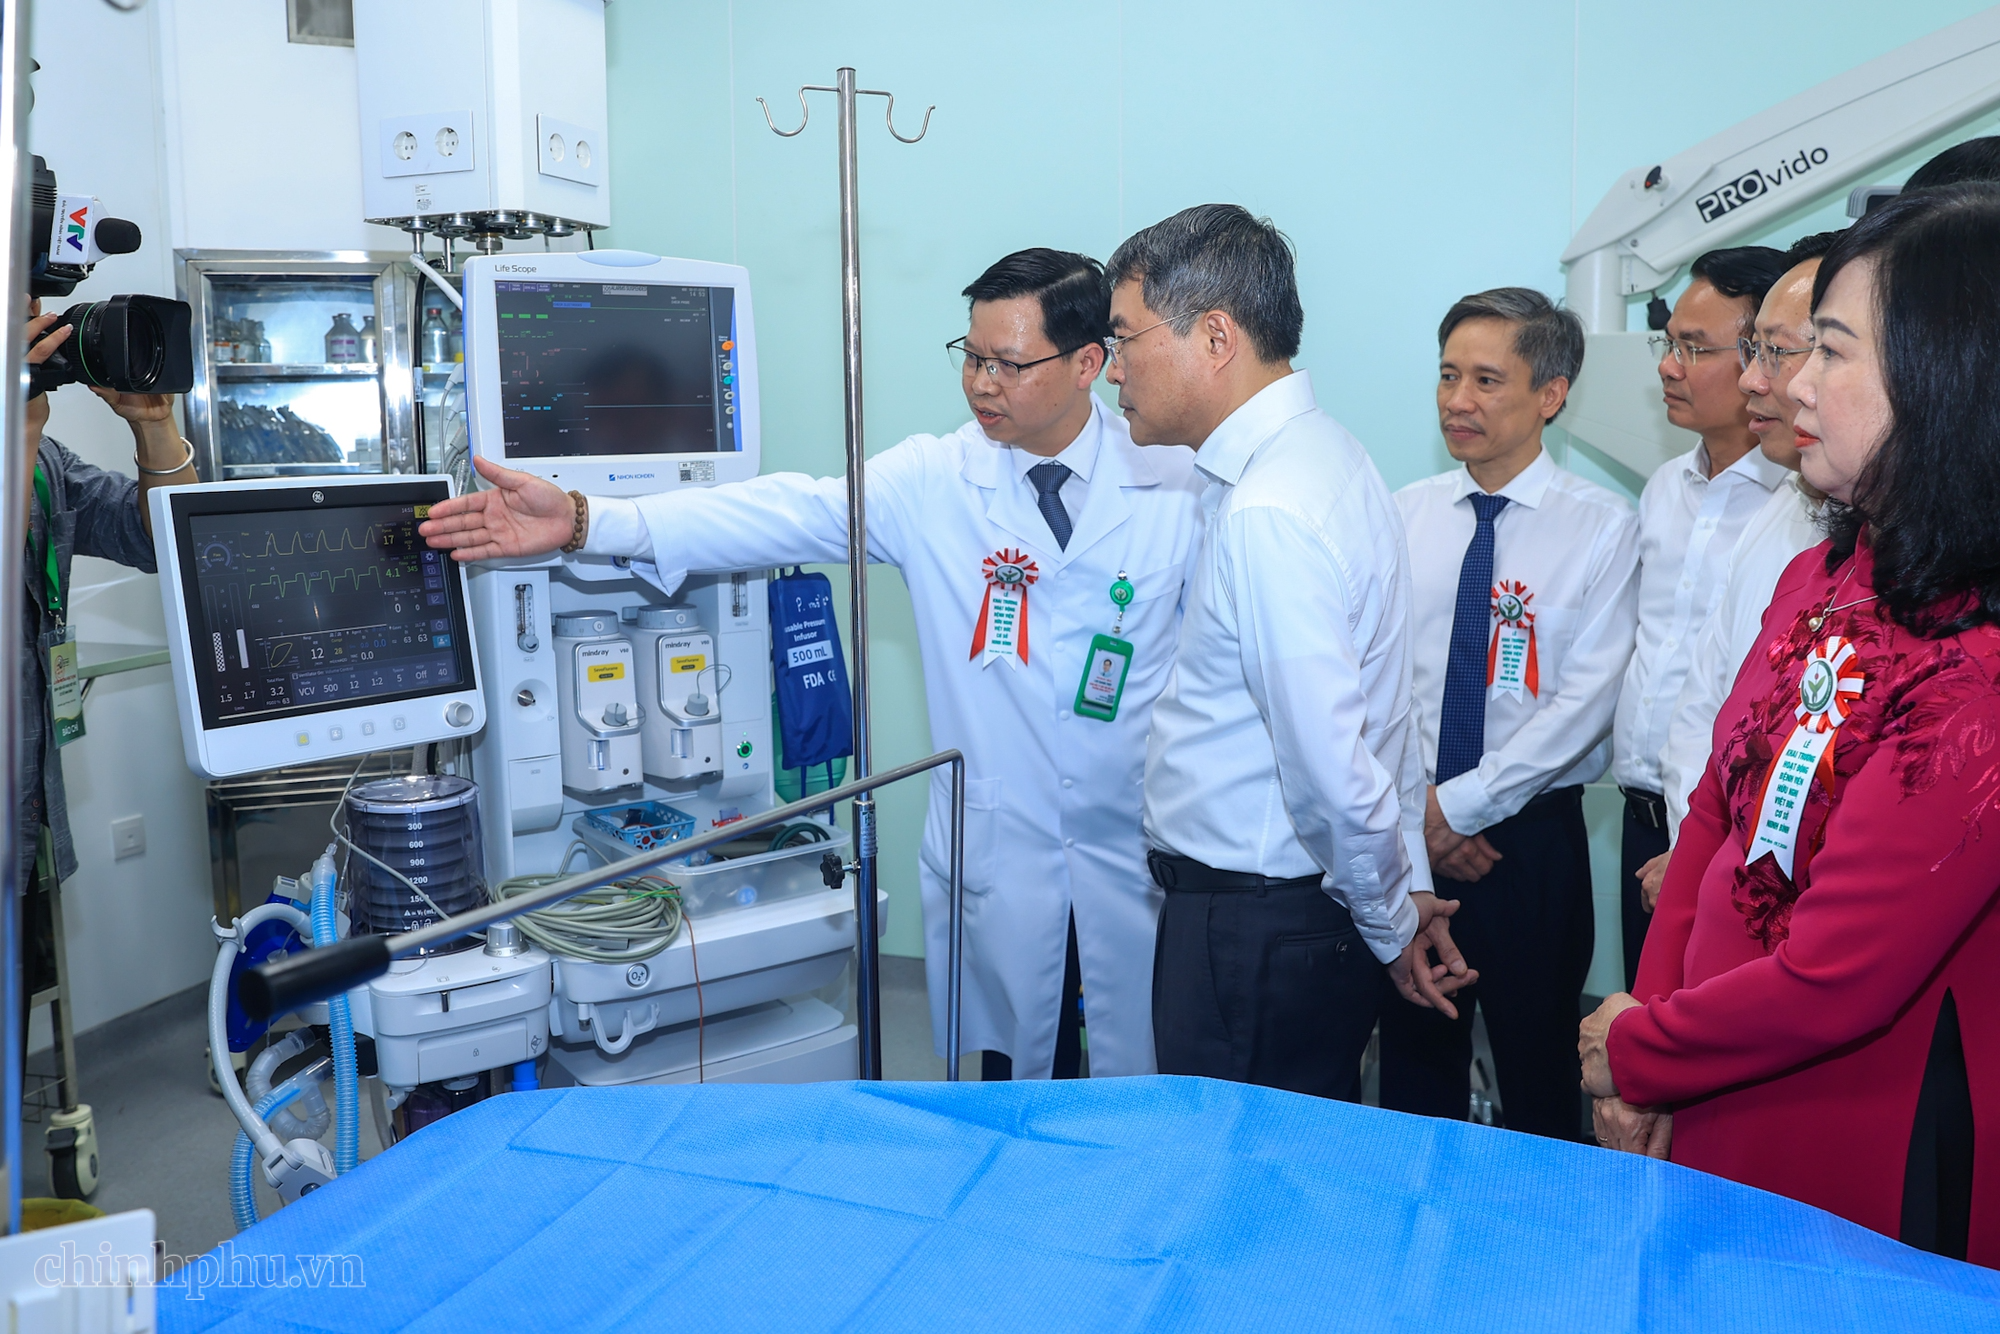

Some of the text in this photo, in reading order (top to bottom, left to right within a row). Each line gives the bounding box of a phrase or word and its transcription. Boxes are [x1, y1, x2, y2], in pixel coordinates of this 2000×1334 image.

[1697, 147, 1828, 223] PROvido
[66, 206, 88, 252] VTV
[512, 265, 537, 274] Scope
[383, 535, 394, 545] 17
[385, 568, 400, 578] 4.1
[395, 603, 401, 613] 0
[418, 634, 428, 642] 63
[794, 631, 817, 642] Infusor
[374, 639, 386, 648] 0.0
[311, 648, 324, 659] 12
[361, 651, 374, 660] 0.0
[793, 646, 827, 663] 500 mL
[416, 670, 427, 679] Off
[350, 681, 359, 689] 12
[372, 677, 383, 686] 1:2
[803, 672, 825, 689] FDA
[270, 687, 284, 696] 3.2
[298, 687, 315, 696] VCV
[323, 684, 338, 693] 500
[220, 694, 232, 702] 1.5
[244, 691, 255, 699] 1.7
